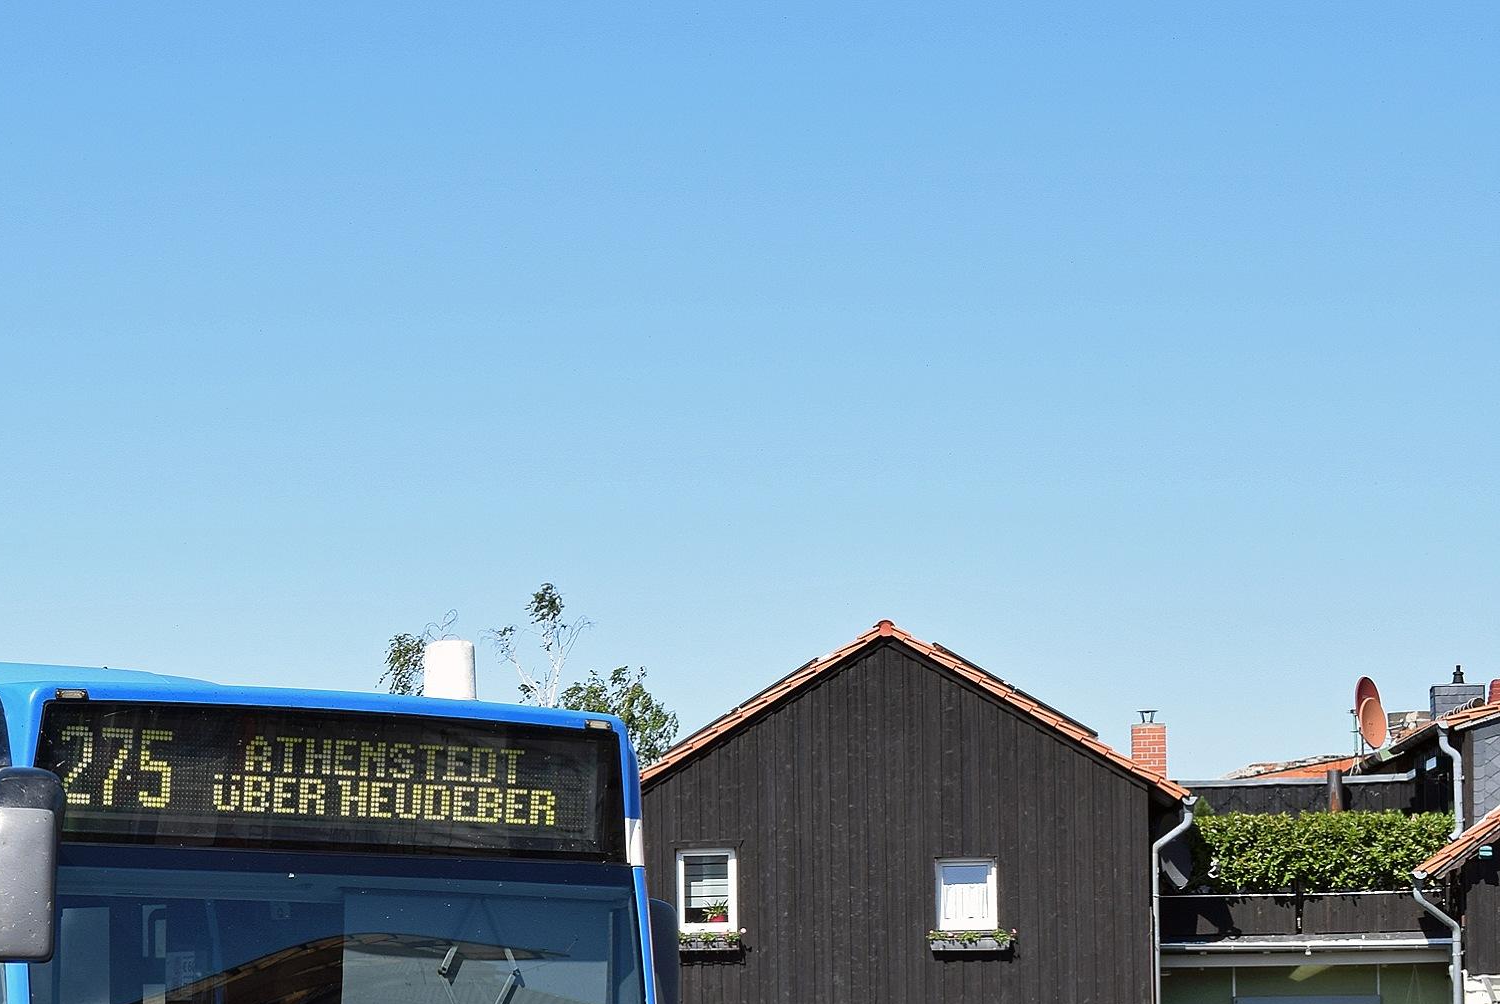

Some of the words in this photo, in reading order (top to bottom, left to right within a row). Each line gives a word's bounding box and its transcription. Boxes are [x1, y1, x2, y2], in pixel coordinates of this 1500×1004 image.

[61, 725, 173, 808] 275
[244, 735, 526, 784] ATHENSTEDT
[337, 780, 556, 826] HEUDEBER
